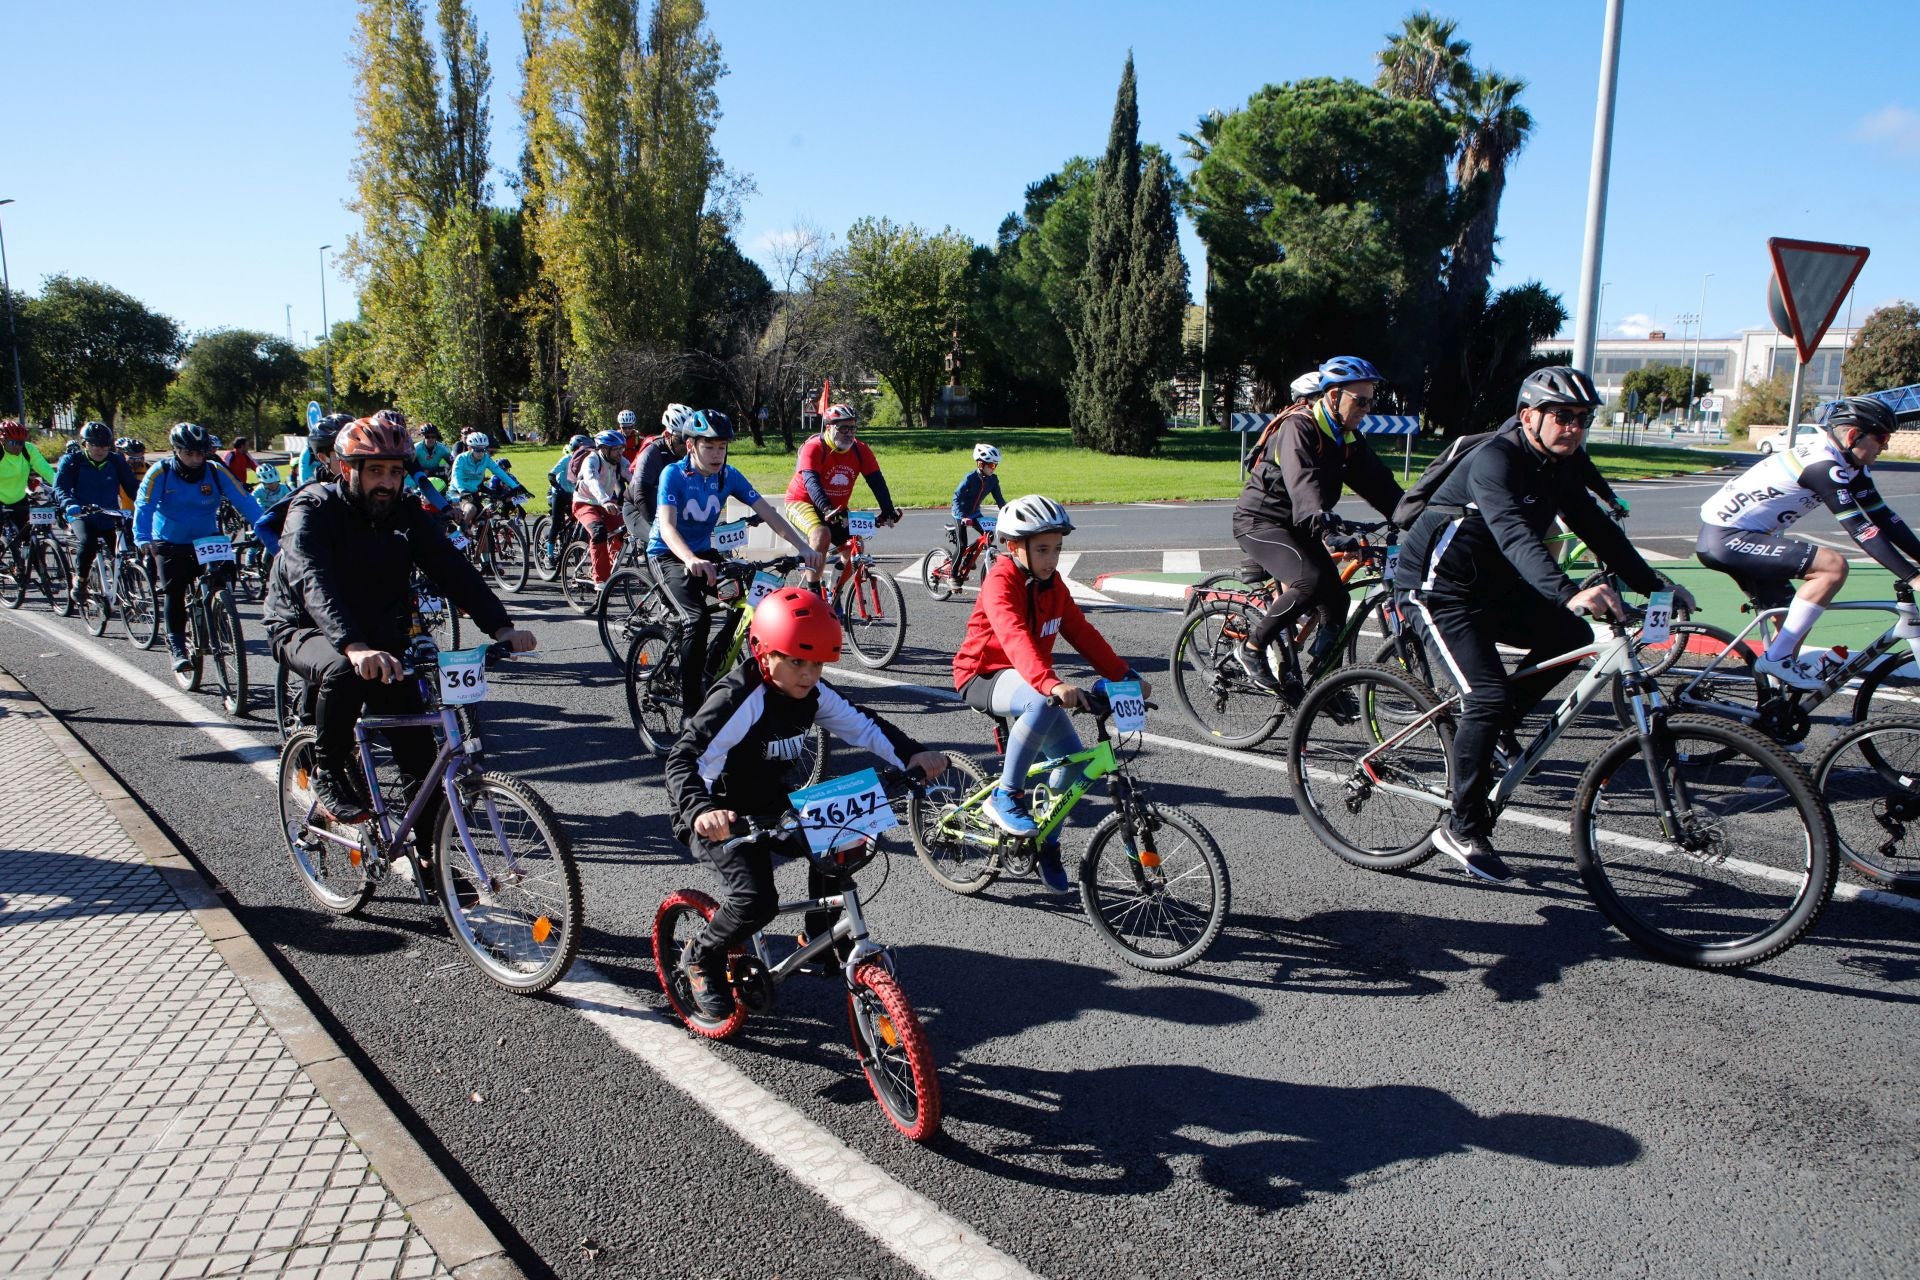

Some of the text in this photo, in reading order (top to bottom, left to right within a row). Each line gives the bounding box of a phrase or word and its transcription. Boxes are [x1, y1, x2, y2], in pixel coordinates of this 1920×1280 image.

[1716, 485, 1785, 522] AUPISA
[851, 520, 873, 529] 3254
[719, 530, 745, 545] 0110
[1725, 537, 1787, 557] RIBBLE
[199, 544, 229, 556] 3527
[1649, 610, 1670, 628] 33
[1804, 637, 1886, 702] TREK
[1115, 699, 1144, 718] 0832
[807, 791, 876, 830] 3647
[1040, 789, 1073, 832] CKRIDER
